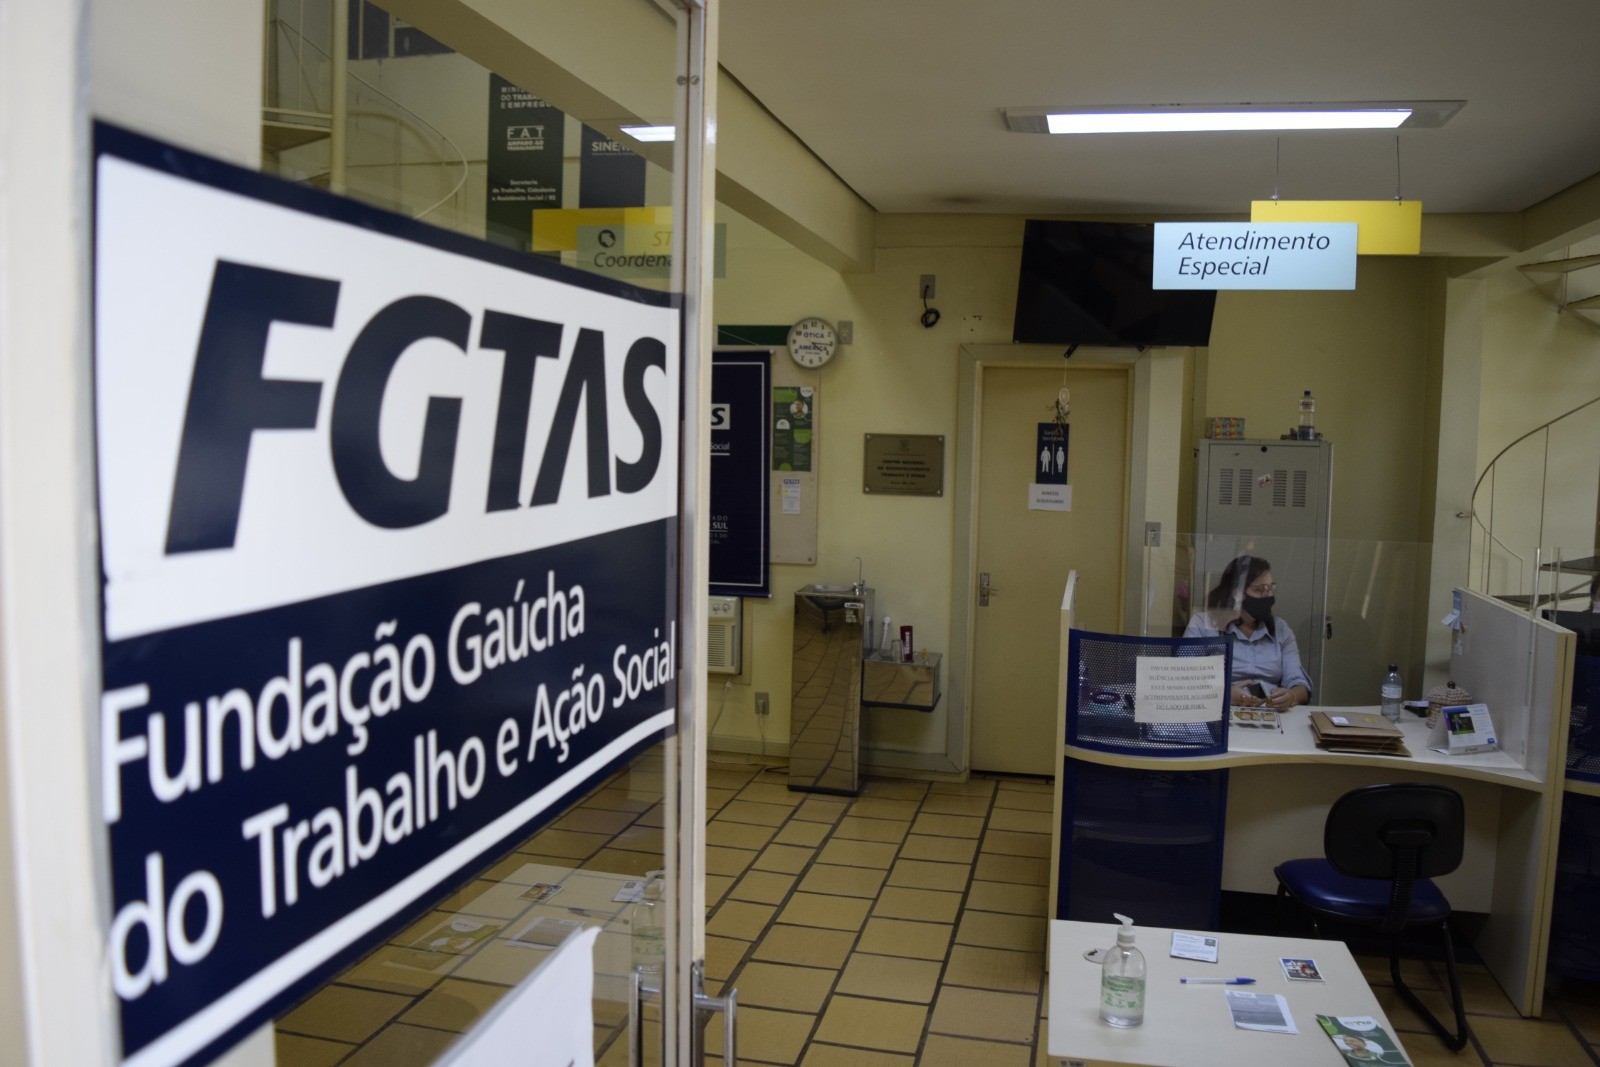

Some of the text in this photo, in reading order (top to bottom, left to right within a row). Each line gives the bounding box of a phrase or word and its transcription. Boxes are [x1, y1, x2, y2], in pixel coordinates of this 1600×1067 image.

[500, 94, 511, 102] DO
[507, 127, 544, 138] FAT
[1178, 230, 1330, 250] Atendimento
[1178, 256, 1270, 280] Especial
[164, 257, 667, 556] FGTAS
[712, 522, 728, 530] SUL
[103, 570, 586, 823] Fundação Gaúcha
[108, 620, 675, 1001] do Trabalho e Ação Social
